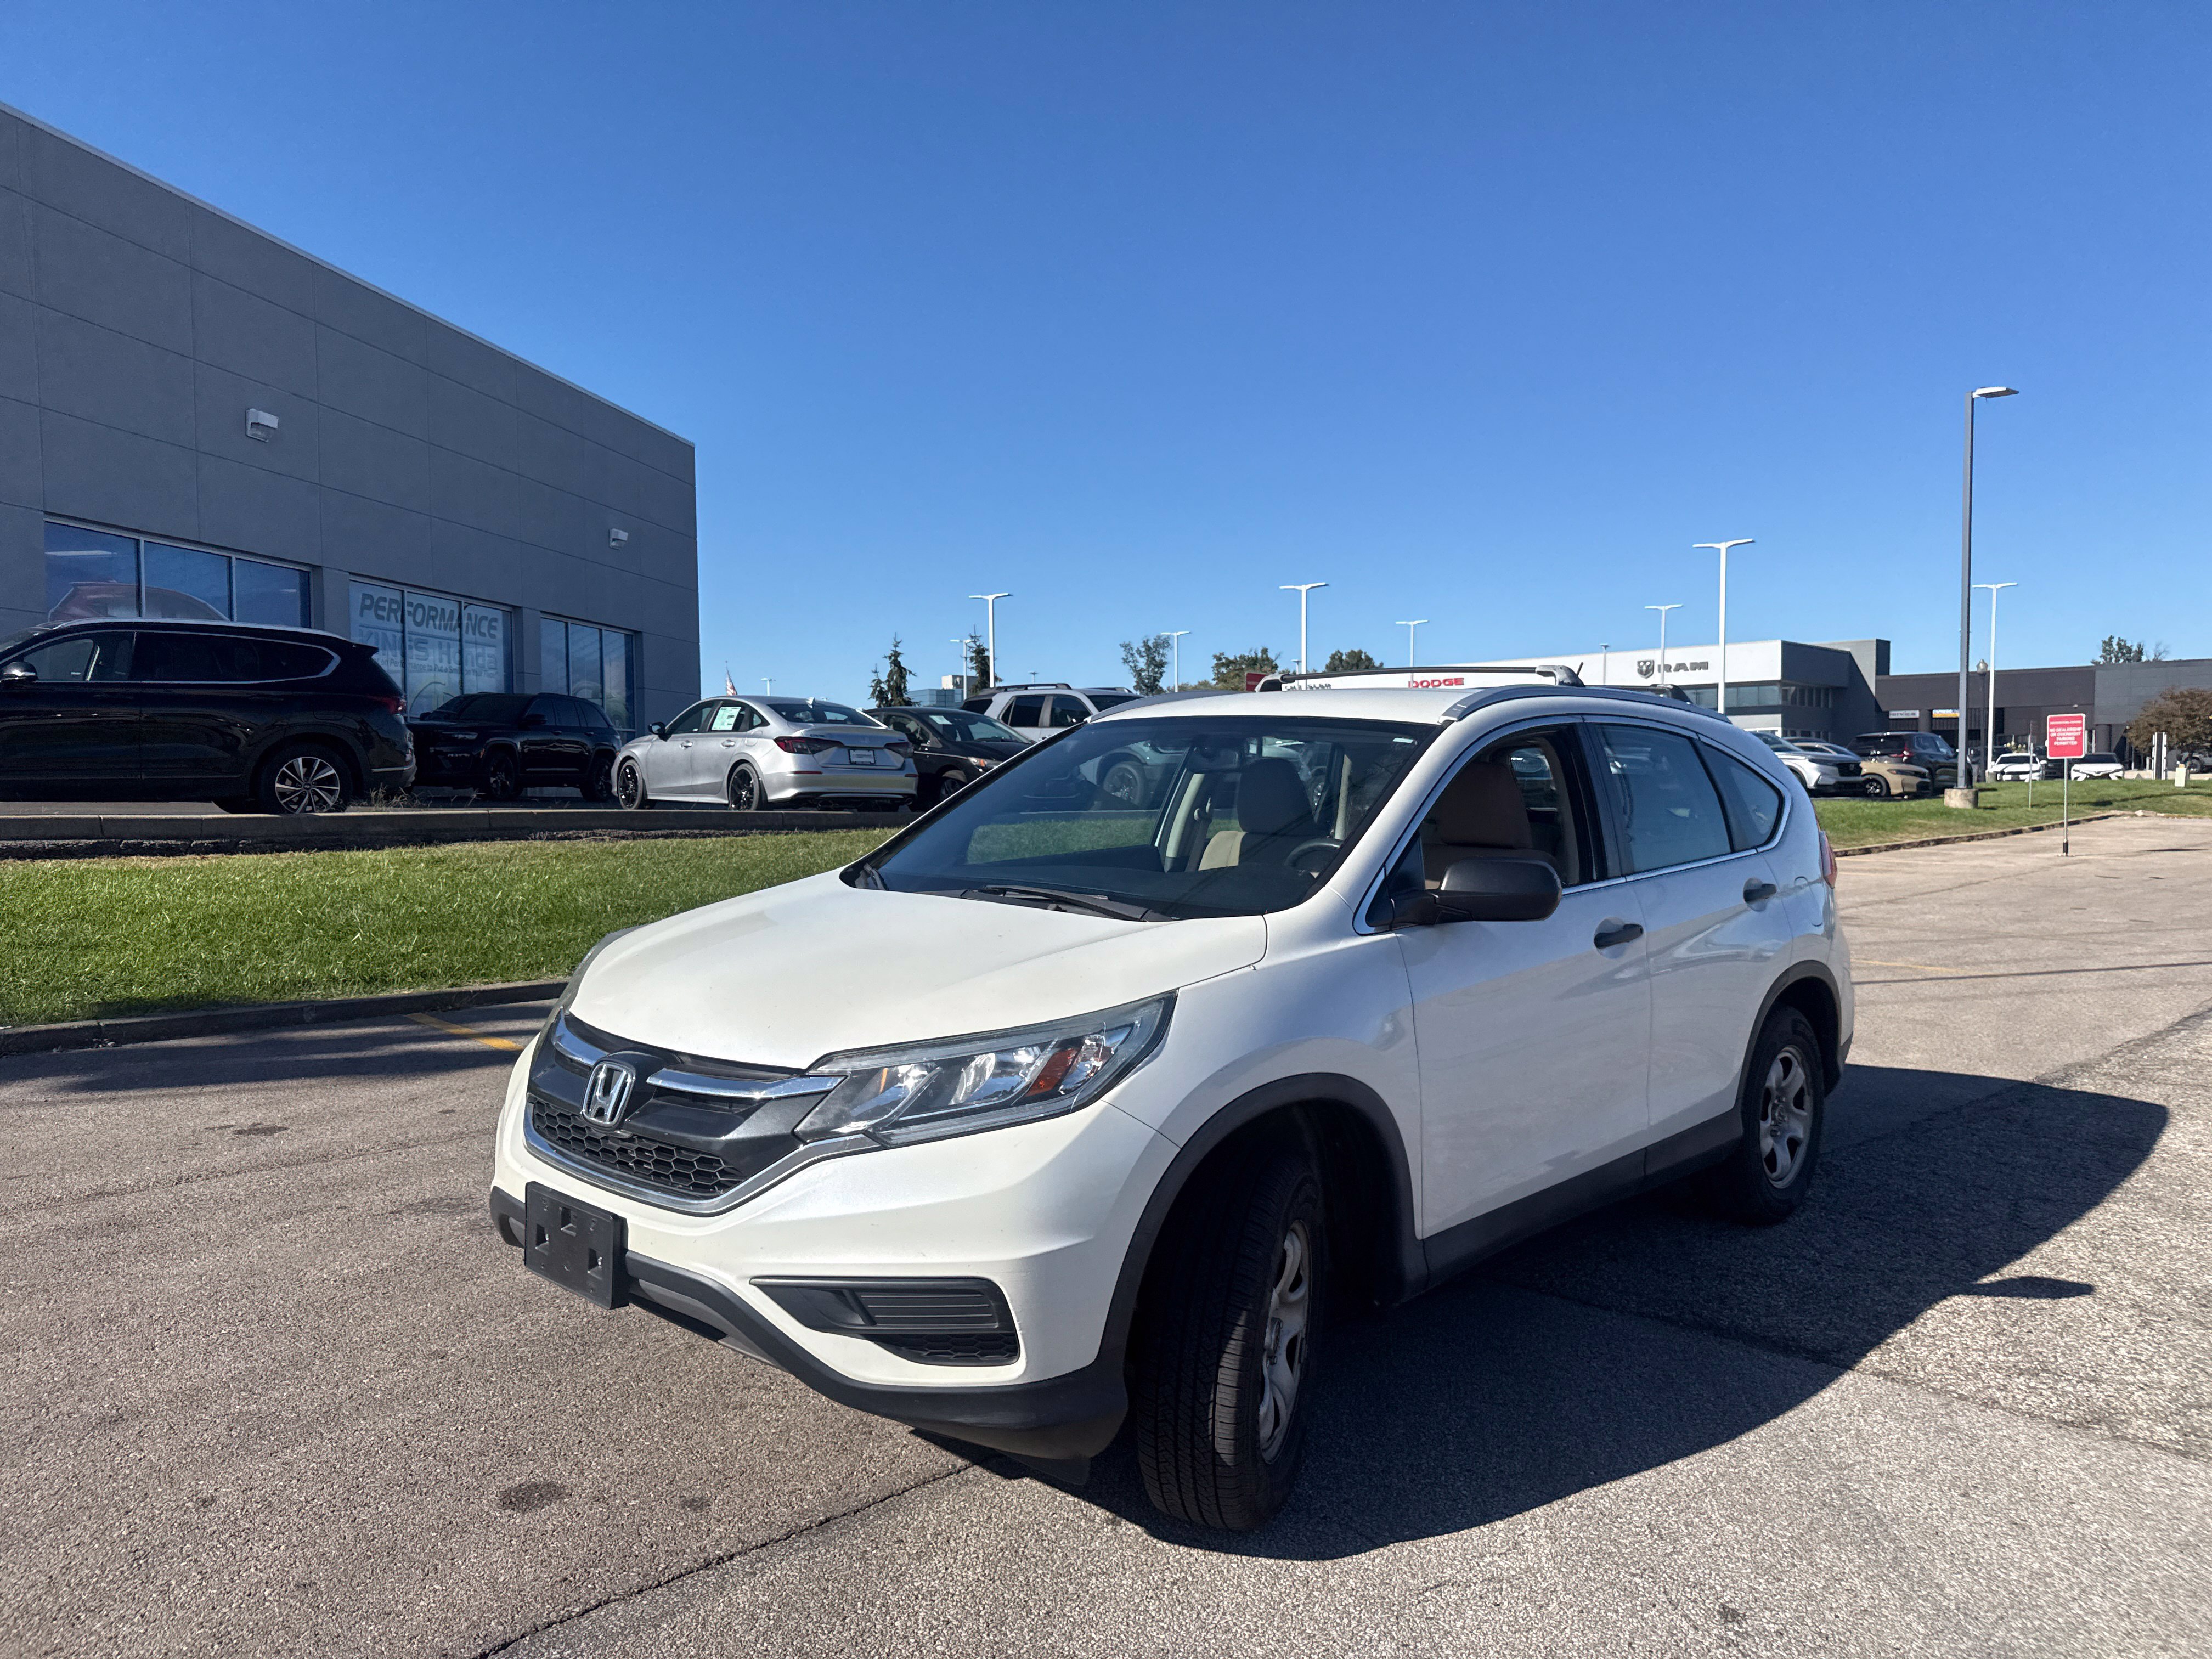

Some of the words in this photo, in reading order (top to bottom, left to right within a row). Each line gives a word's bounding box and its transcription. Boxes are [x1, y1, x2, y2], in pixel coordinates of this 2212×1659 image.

[438, 640, 498, 670] Honda
[390, 658, 426, 672] Perfomance
[1657, 661, 1709, 673] RAM
[1408, 678, 1465, 689] DODGE
